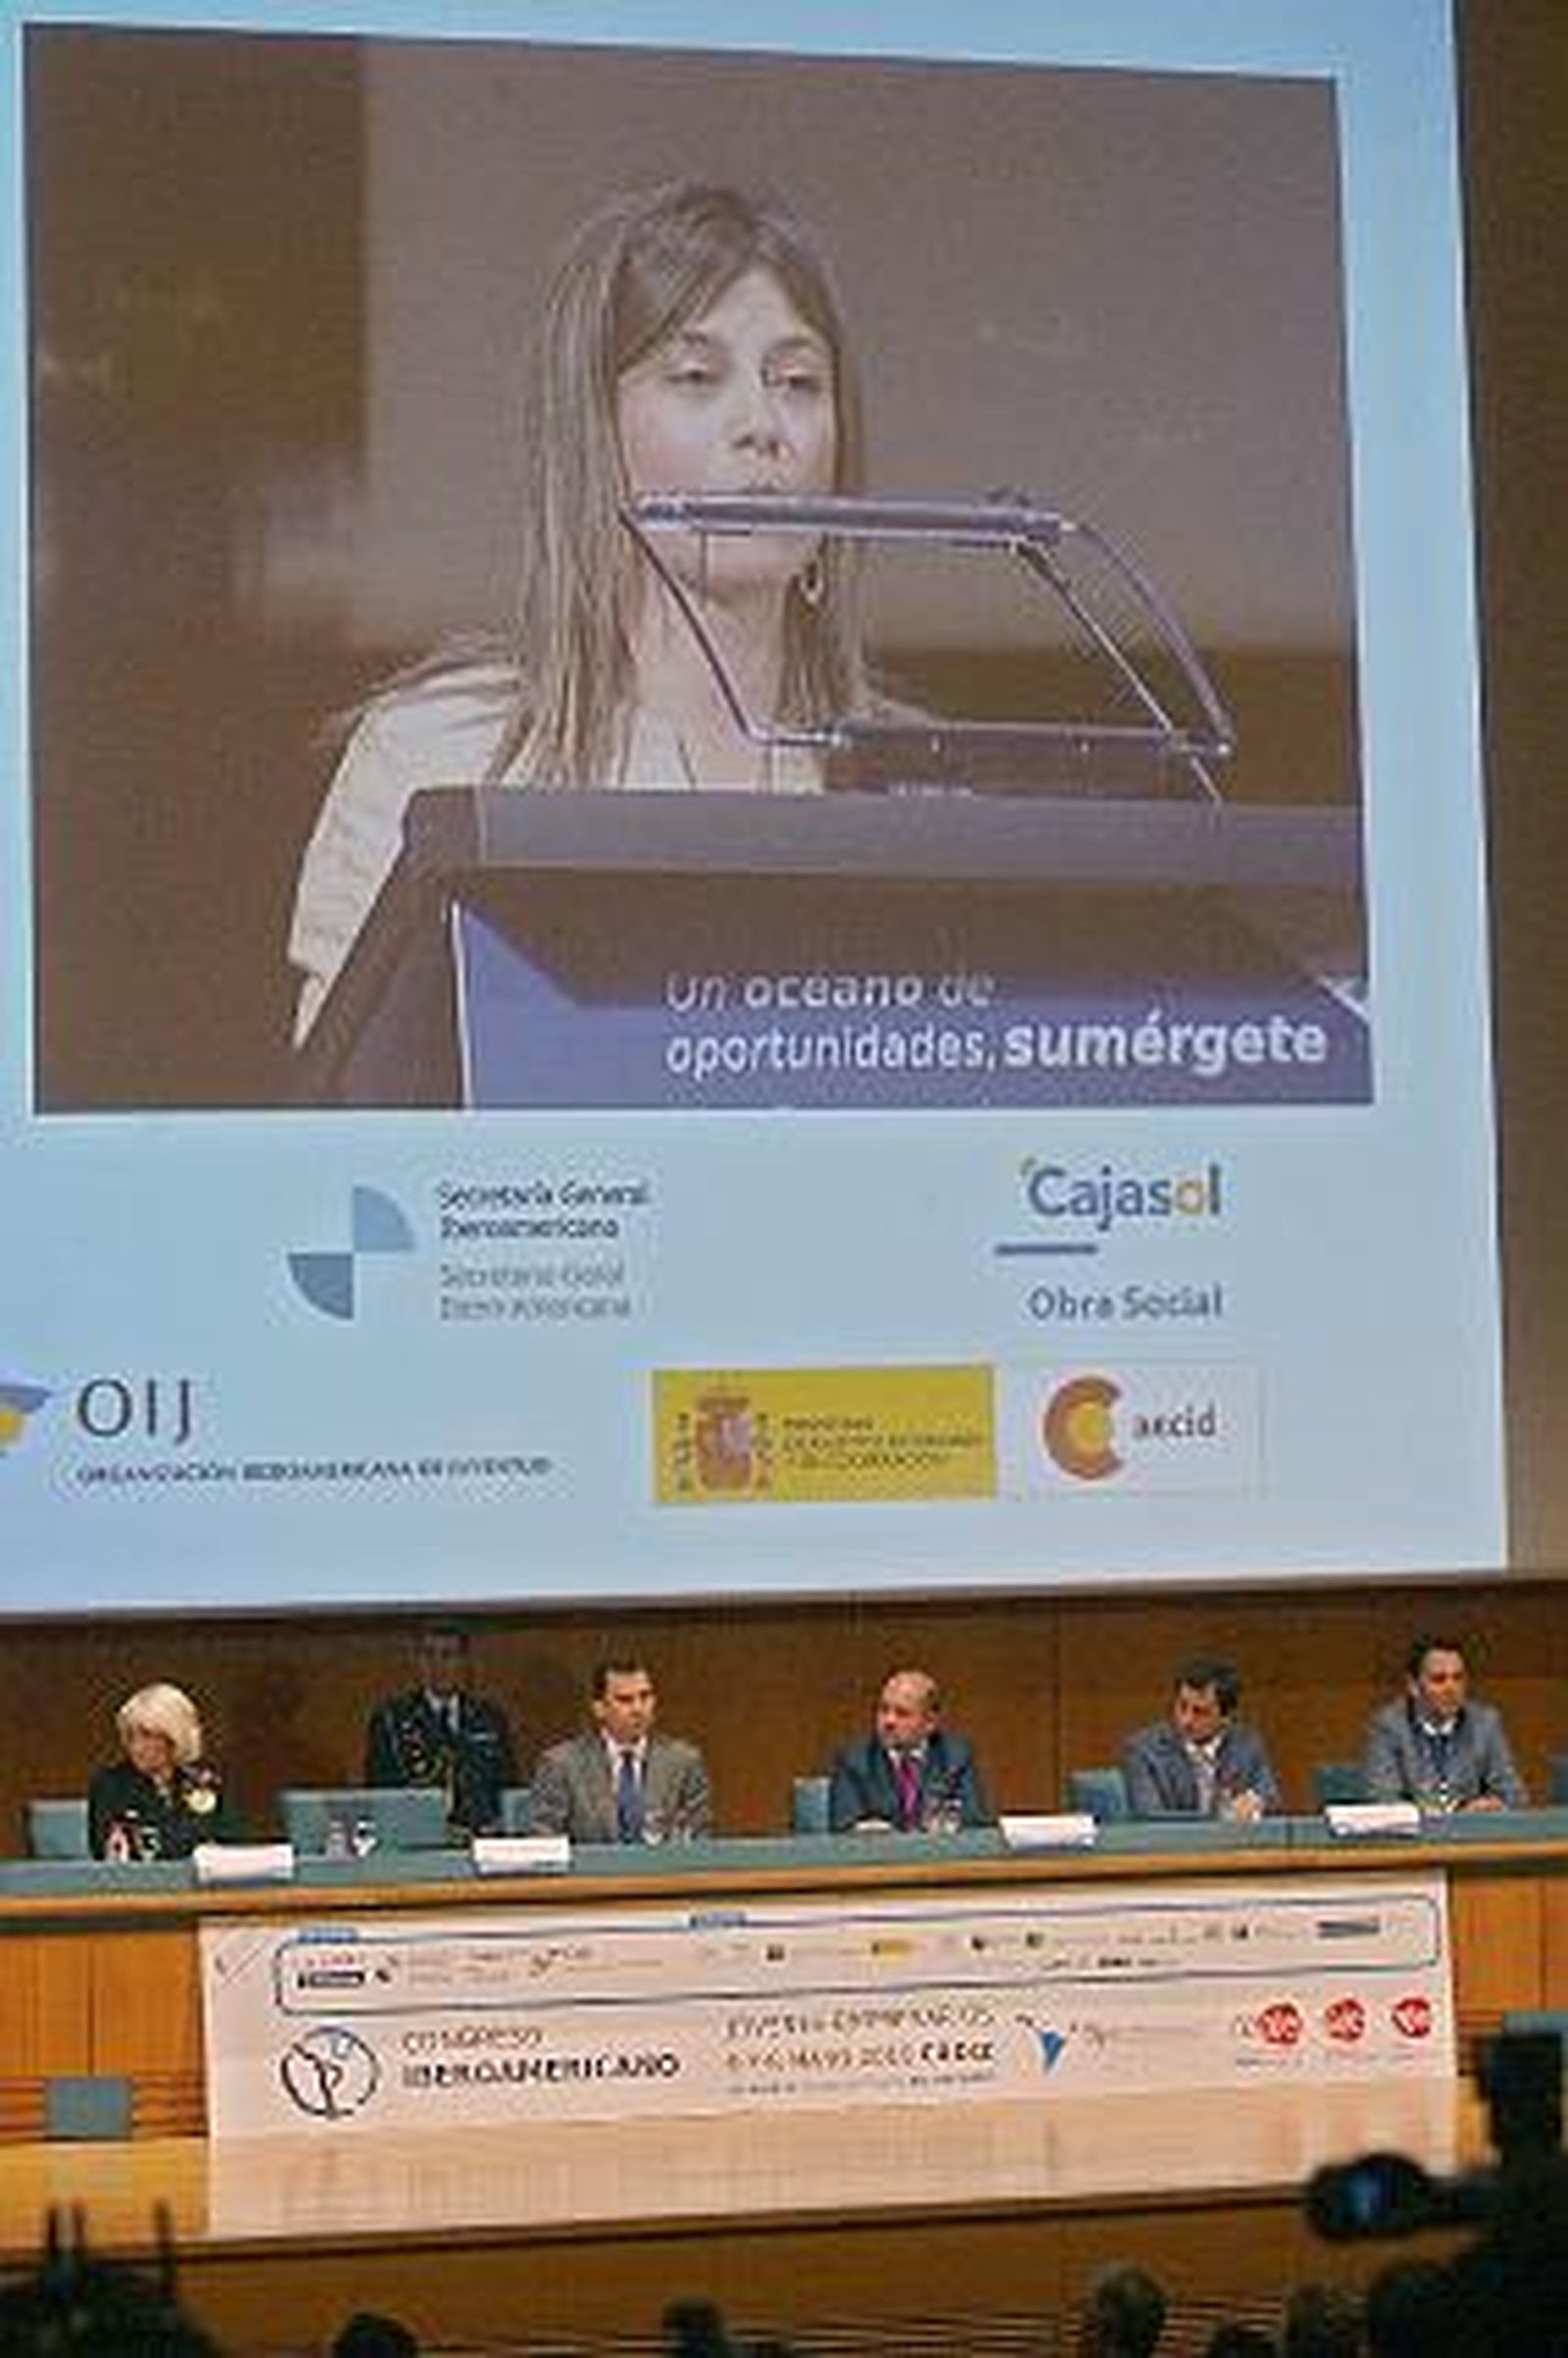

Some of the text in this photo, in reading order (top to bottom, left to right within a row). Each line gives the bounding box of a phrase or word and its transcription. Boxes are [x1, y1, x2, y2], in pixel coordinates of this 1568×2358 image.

[666, 1008, 1326, 1080] oportunidades, sumérgete
[1028, 1163, 1221, 1230] Cajasol
[1029, 1280, 1222, 1321] Obra Social
[78, 1378, 190, 1447] OIJ
